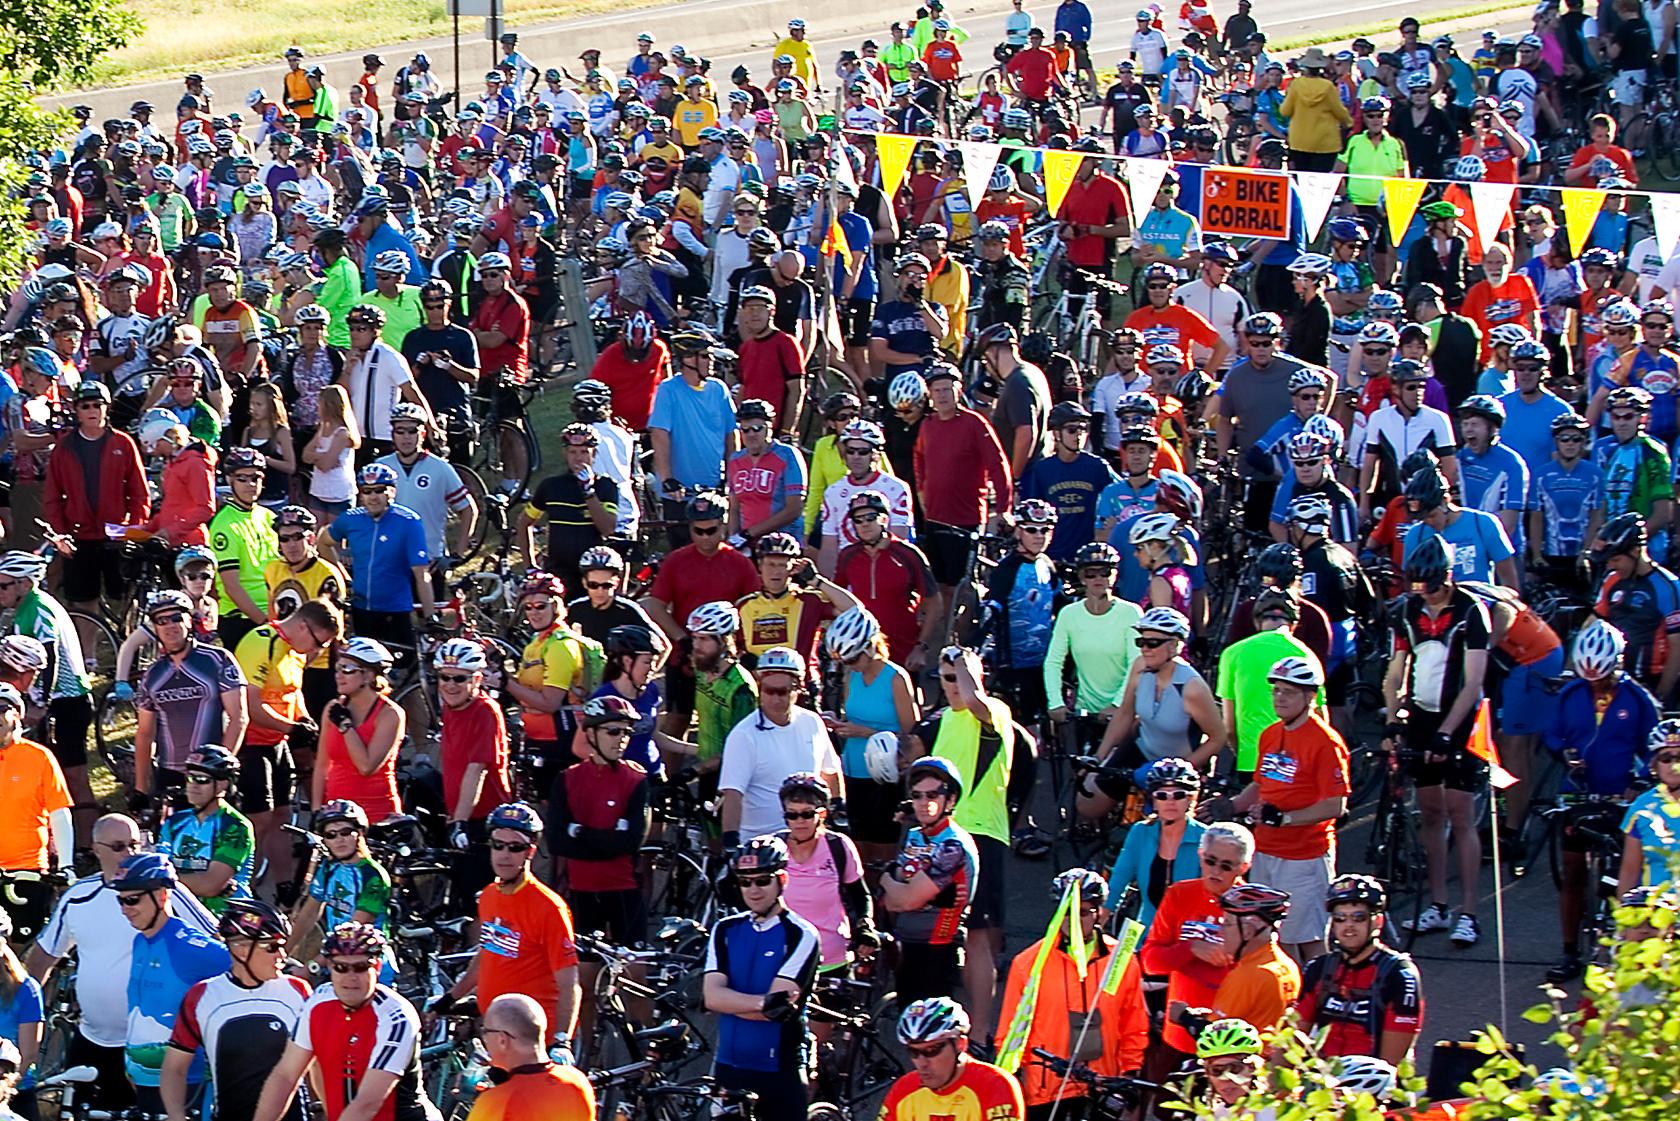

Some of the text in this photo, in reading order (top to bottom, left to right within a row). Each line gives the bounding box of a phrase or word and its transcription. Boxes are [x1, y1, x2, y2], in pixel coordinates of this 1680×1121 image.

[1236, 178, 1279, 205] BIKE
[1207, 204, 1284, 232] CORRAL
[416, 475, 430, 488] 6
[733, 467, 776, 494] SJU
